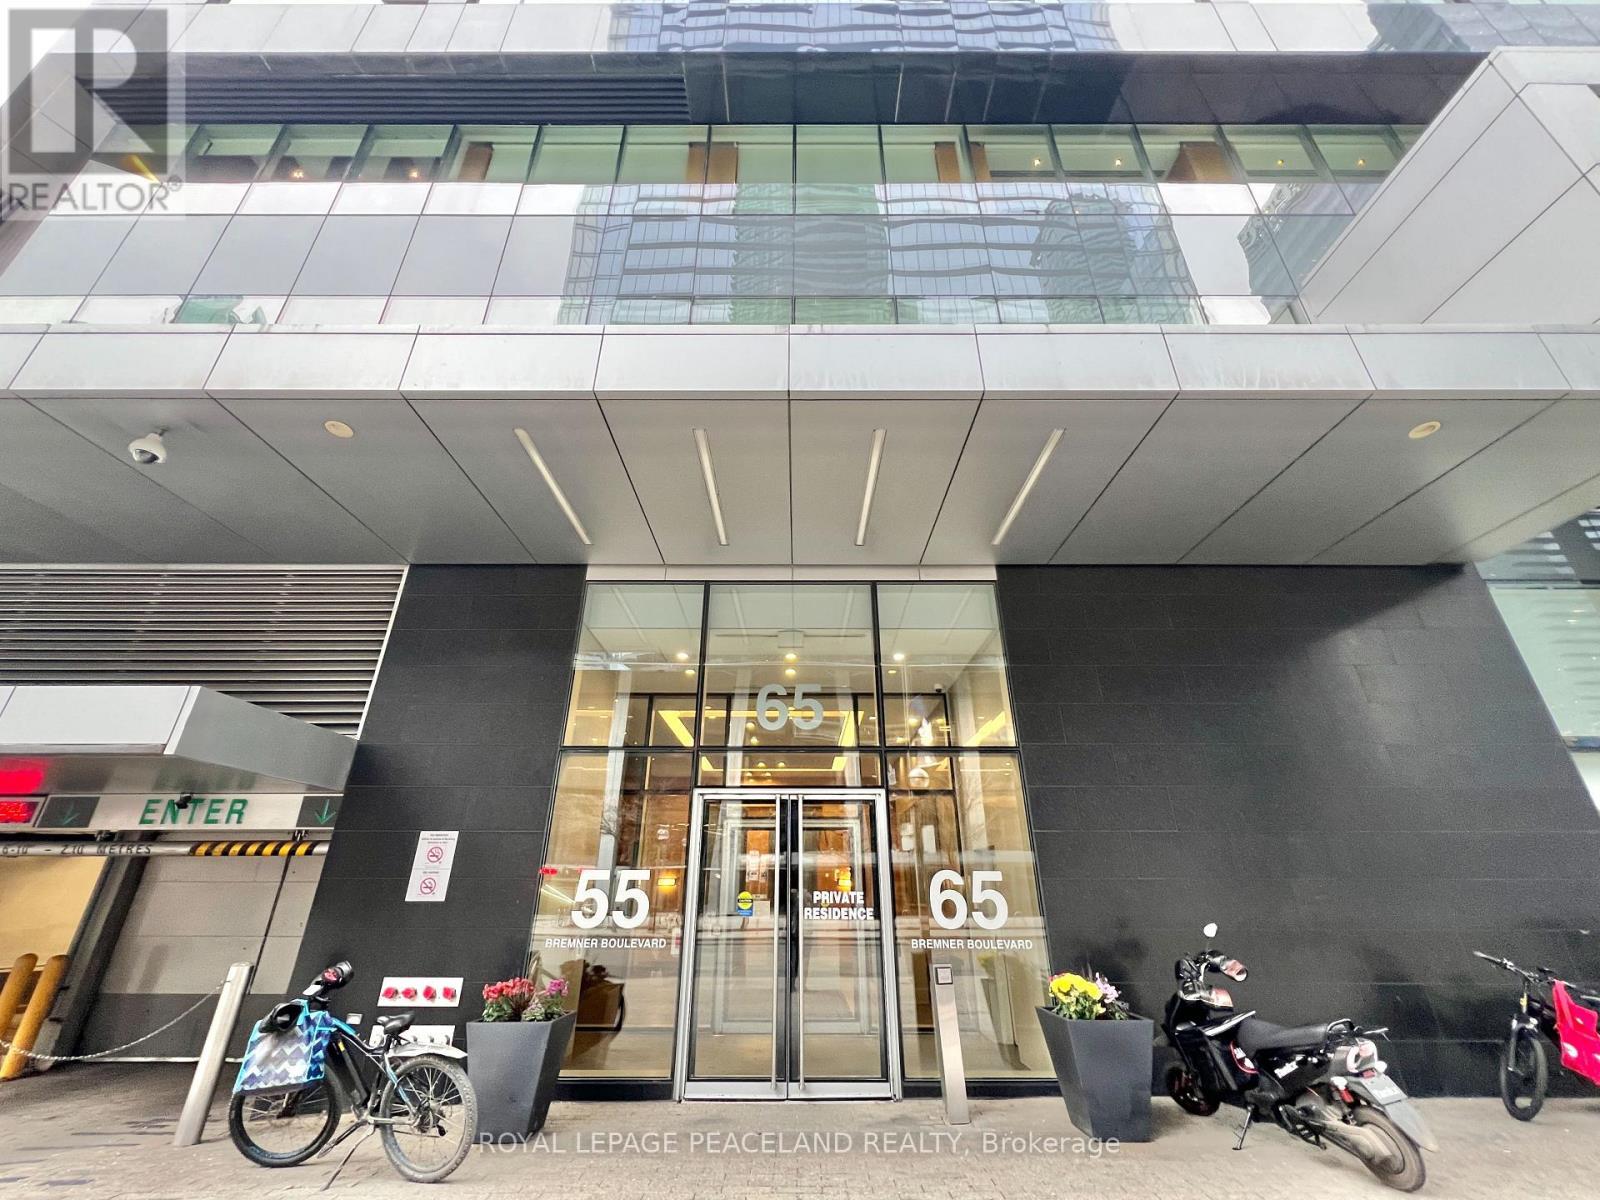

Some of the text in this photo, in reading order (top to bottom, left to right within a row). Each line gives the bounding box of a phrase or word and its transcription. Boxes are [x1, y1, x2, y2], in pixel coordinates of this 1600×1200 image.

[756, 683, 824, 731] 65
[139, 798, 248, 825] ENTER
[571, 869, 651, 929] 55
[813, 890, 864, 904] PRIVATE
[929, 869, 1009, 930] 65
[803, 907, 874, 920] RESIDENCE
[545, 938, 667, 949] BREMNER BOULEVARD
[911, 938, 1033, 949] BREMNER BOULEVARD
